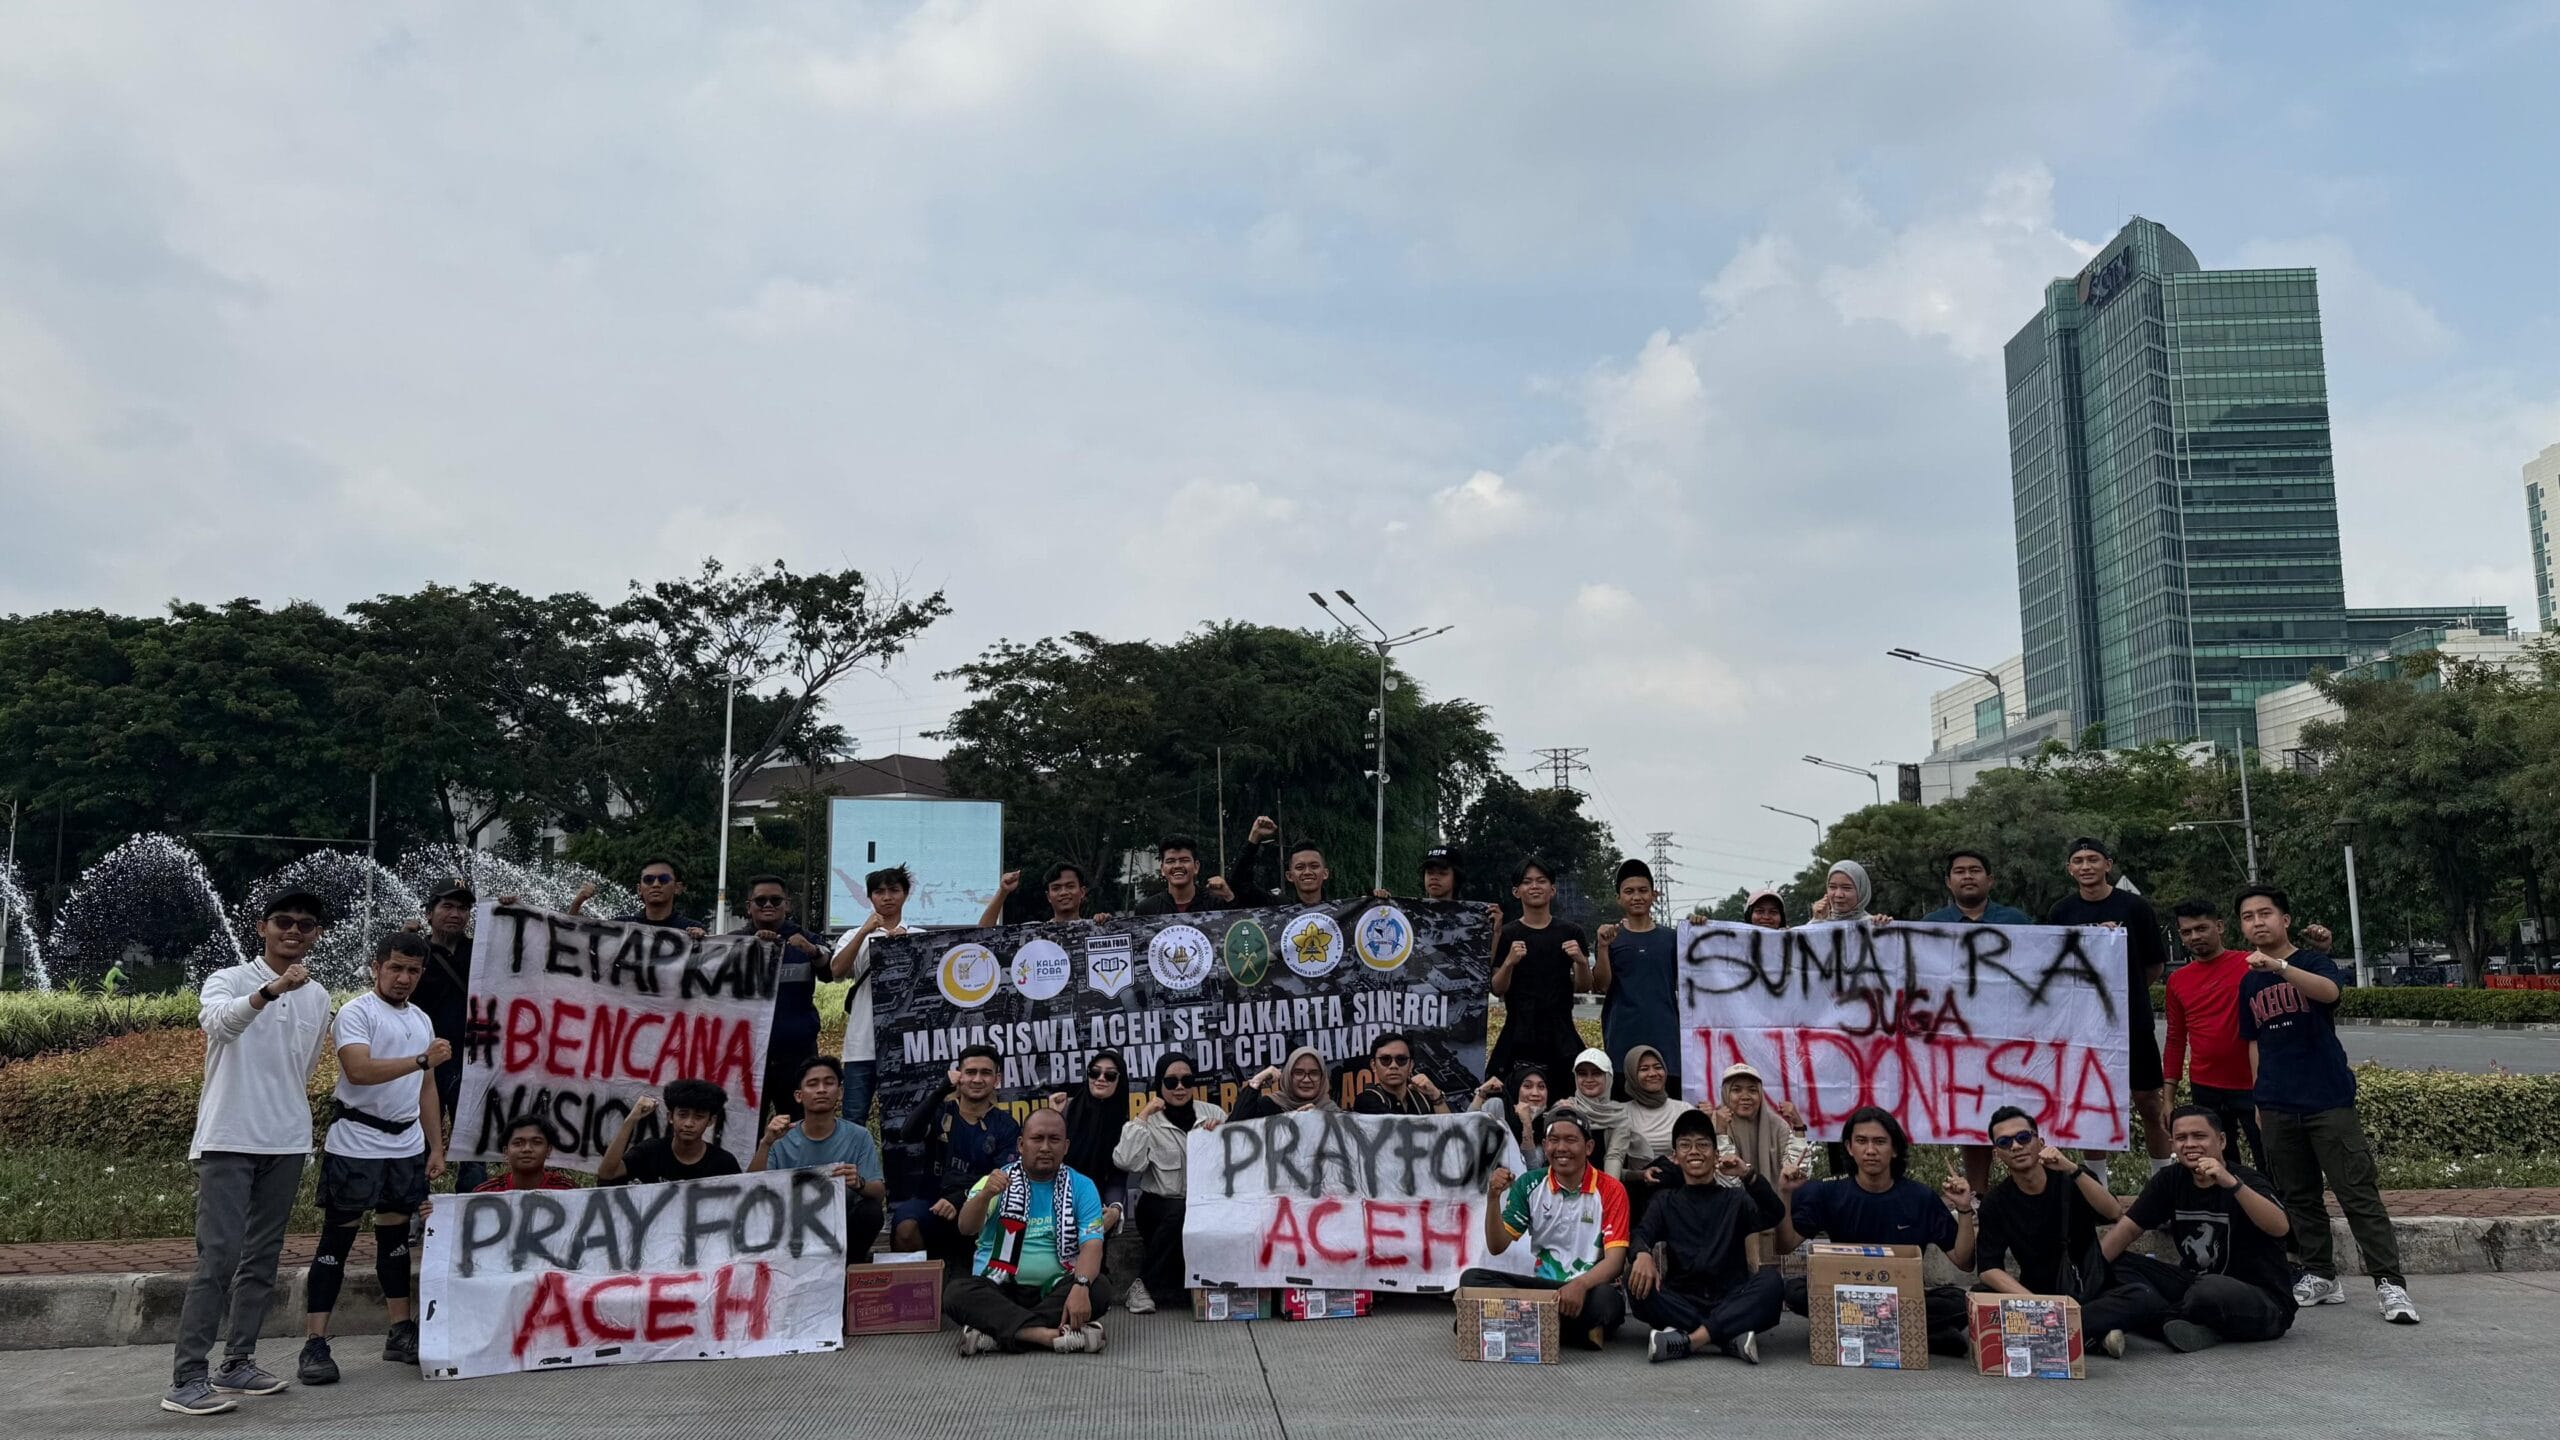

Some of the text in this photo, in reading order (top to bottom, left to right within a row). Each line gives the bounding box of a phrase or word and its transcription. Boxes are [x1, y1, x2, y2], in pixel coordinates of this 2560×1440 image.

[492, 906, 782, 999] TETAPKAN
[1036, 958, 1068, 967] KALAM
[1036, 967, 1062, 975] FOBA
[1089, 938, 1128, 949] WISMA FOBA
[1684, 925, 2117, 1025] SUMATRA
[464, 994, 757, 1108] #BENCANA
[903, 989, 1448, 1064] MAHASISWA ACEH SE-JAKARTA SINERGI
[1837, 985, 1975, 1044] JUGA
[1197, 1038, 1224, 1072] DI
[1235, 1033, 1287, 1068] CFD
[1693, 1026, 2126, 1144] INDONESIA
[1259, 1197, 1469, 1271] ACEH
[511, 1261, 773, 1360] ACEH
